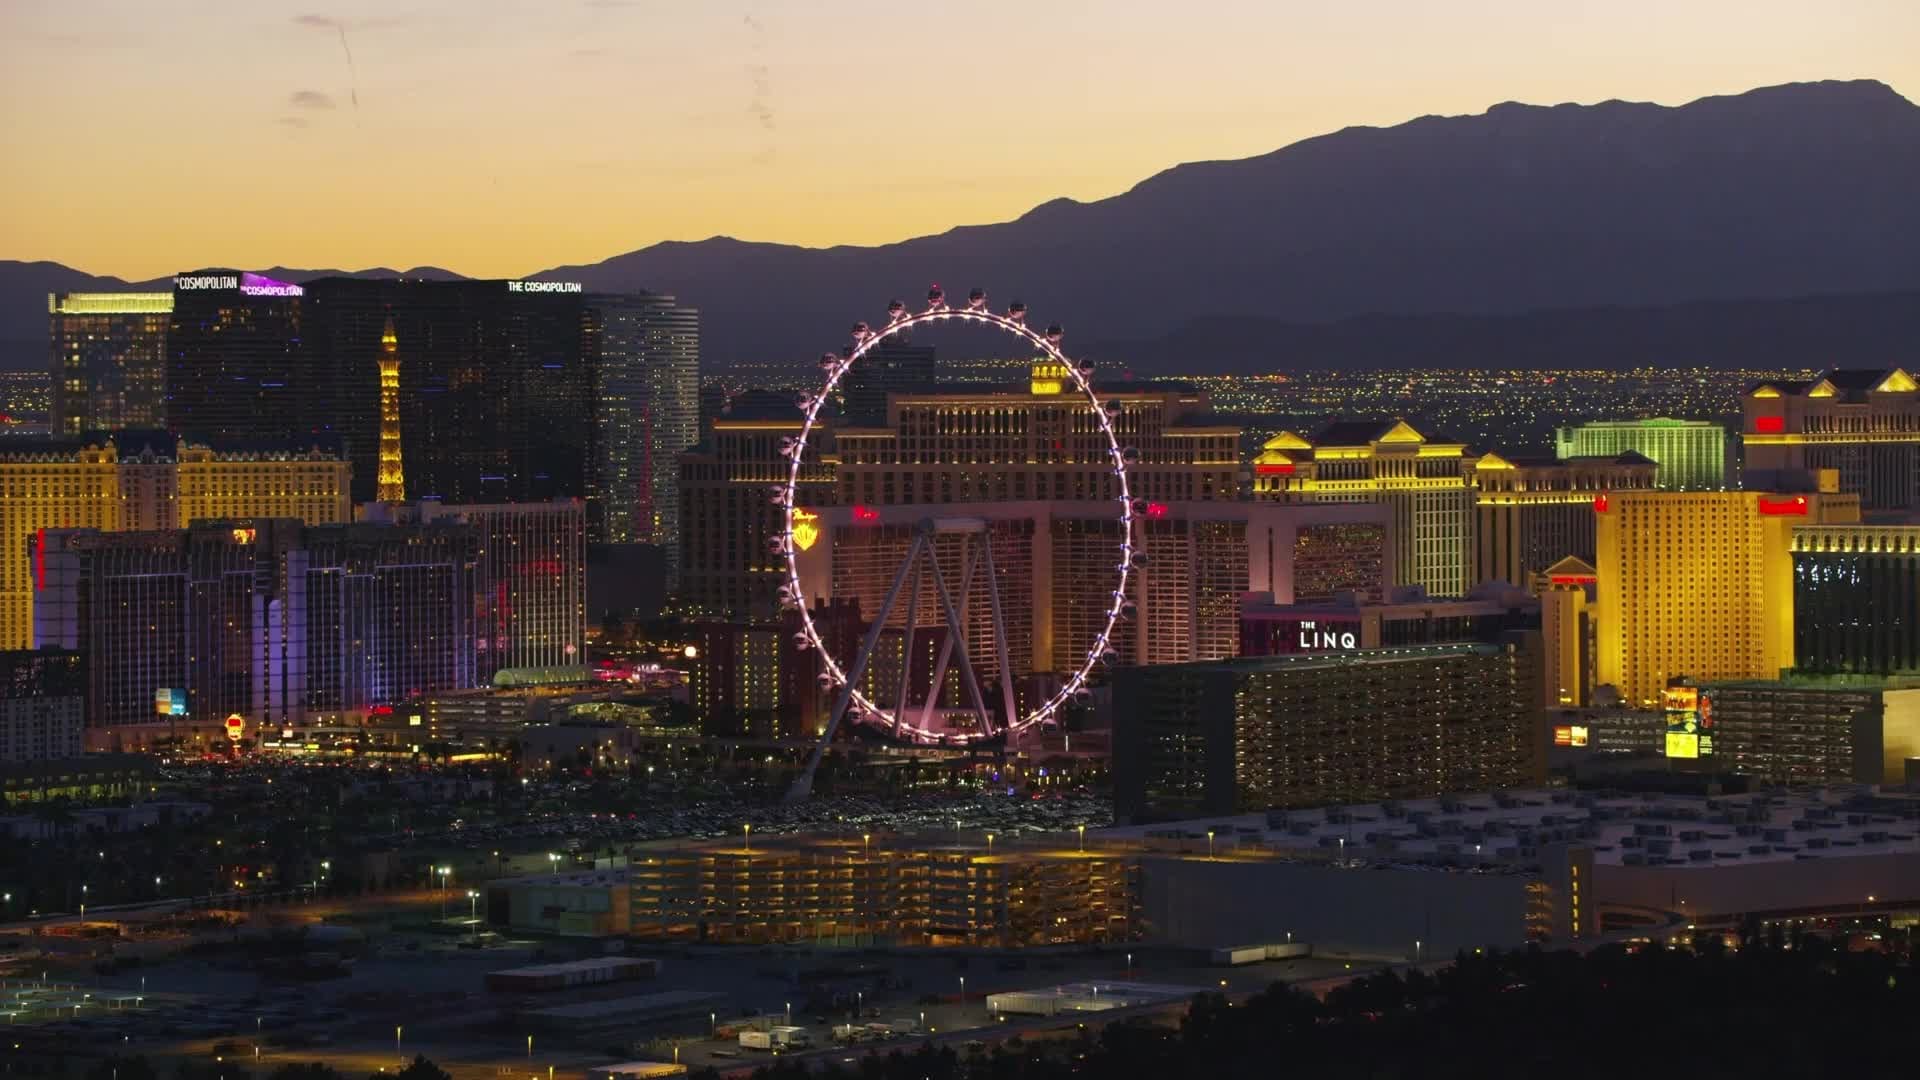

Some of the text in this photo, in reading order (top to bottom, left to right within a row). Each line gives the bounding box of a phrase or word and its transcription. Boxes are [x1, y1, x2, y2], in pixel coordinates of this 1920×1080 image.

[180, 276, 237, 289] COSMOPOLITAN
[508, 281, 581, 292] THE COSMOPOLITAN
[246, 286, 303, 296] COSMOPOLITAN
[1300, 621, 1315, 629] THE
[1300, 632, 1355, 648] LINQ
